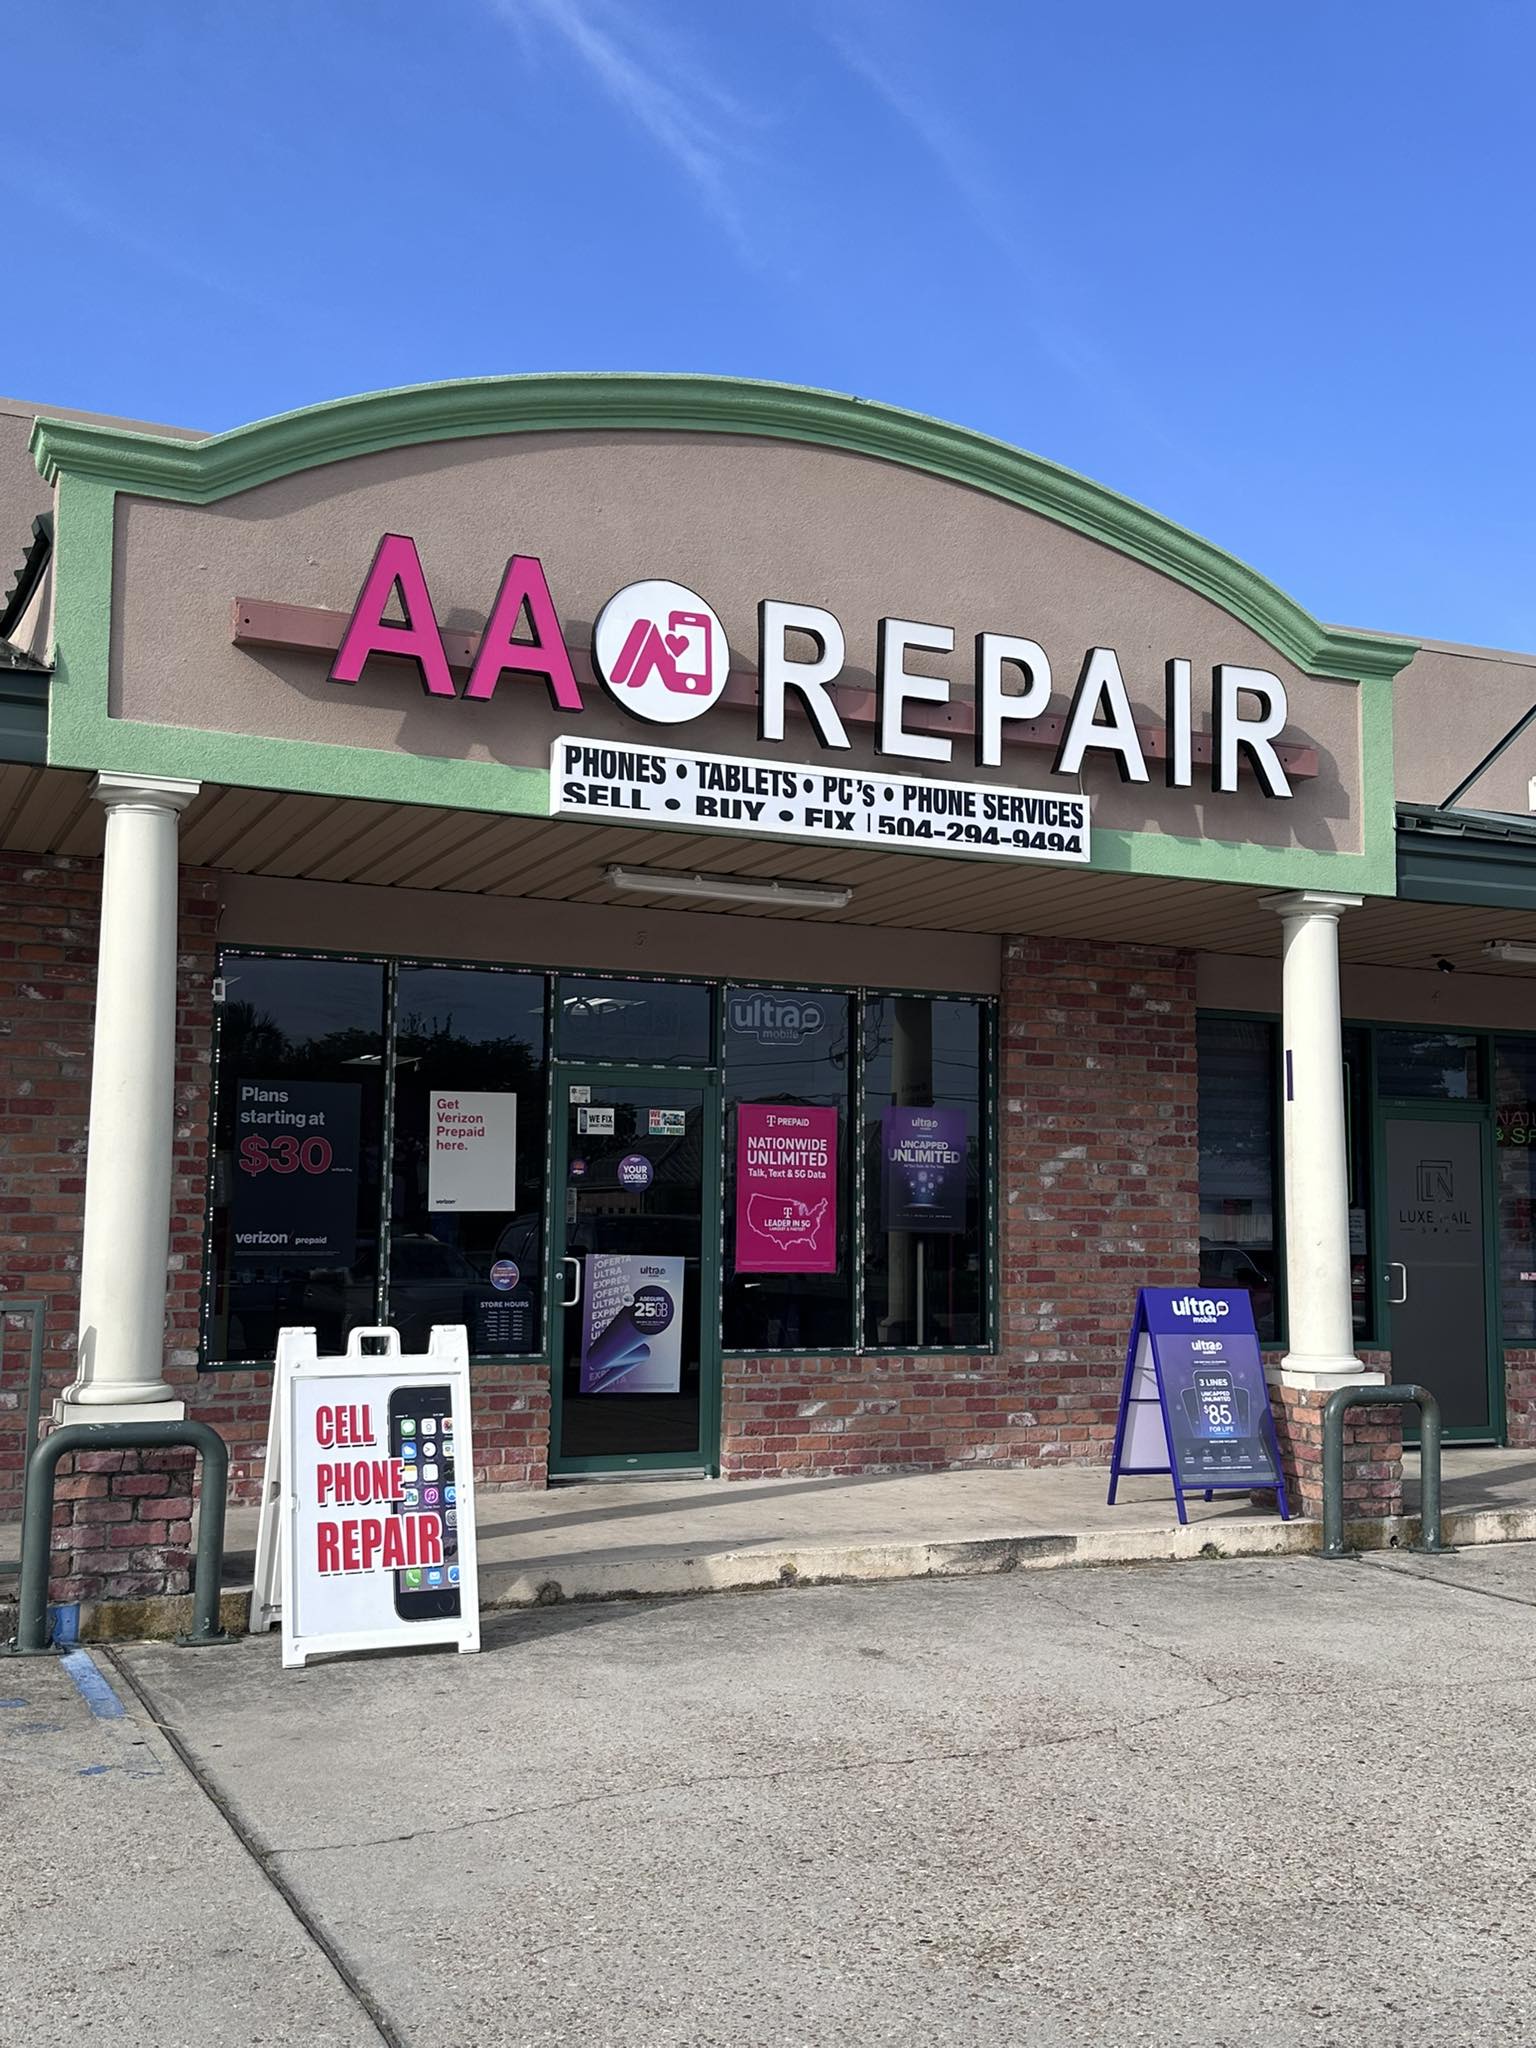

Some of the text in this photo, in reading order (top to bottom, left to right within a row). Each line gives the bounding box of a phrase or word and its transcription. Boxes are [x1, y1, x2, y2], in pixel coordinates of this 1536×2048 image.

[327, 533, 1294, 799] AA REPAIR
[565, 745, 667, 784] PHONES
[695, 760, 797, 799] TABLETS
[903, 785, 976, 818] PHONE
[983, 794, 1084, 829] SERVICES
[563, 782, 1082, 853] SELL BUY FIX 504-294-9494
[735, 999, 800, 1028] ultra
[762, 1029, 800, 1039] mobile
[241, 1086, 289, 1103] Plans
[437, 1098, 460, 1110] Get
[240, 1109, 325, 1128] starting at
[437, 1112, 484, 1123] Verizon
[777, 1117, 810, 1127] PREPAID
[911, 1117, 932, 1127] ultra
[436, 1126, 485, 1138] Prepaid
[436, 1139, 468, 1151] here.
[747, 1136, 828, 1151] NATIONWIDE
[900, 1140, 949, 1150] UNCAPPED
[239, 1133, 333, 1177] $30
[747, 1150, 828, 1167] UNLIMITED
[888, 1148, 961, 1164] UNLIMITED
[623, 1165, 648, 1174] YOUR
[748, 1168, 827, 1179] Talk, Text & 5G Data
[1399, 1209, 1472, 1224] LUXE AIL
[764, 1219, 811, 1228] LEADER IN 5G
[234, 1230, 289, 1244] verizon
[295, 1236, 328, 1246] prepaid
[594, 1266, 622, 1279] ULTRA
[640, 1266, 660, 1274] ultra
[592, 1297, 621, 1310] ULTRA
[1171, 1296, 1217, 1316] ultra
[1191, 1339, 1216, 1351] ultra
[1199, 1378, 1228, 1387] 3 LINES
[1203, 1404, 1232, 1425] $85
[315, 1404, 376, 1446] CELL
[316, 1459, 405, 1504] PHONE
[316, 1514, 442, 1573] REPAIR
